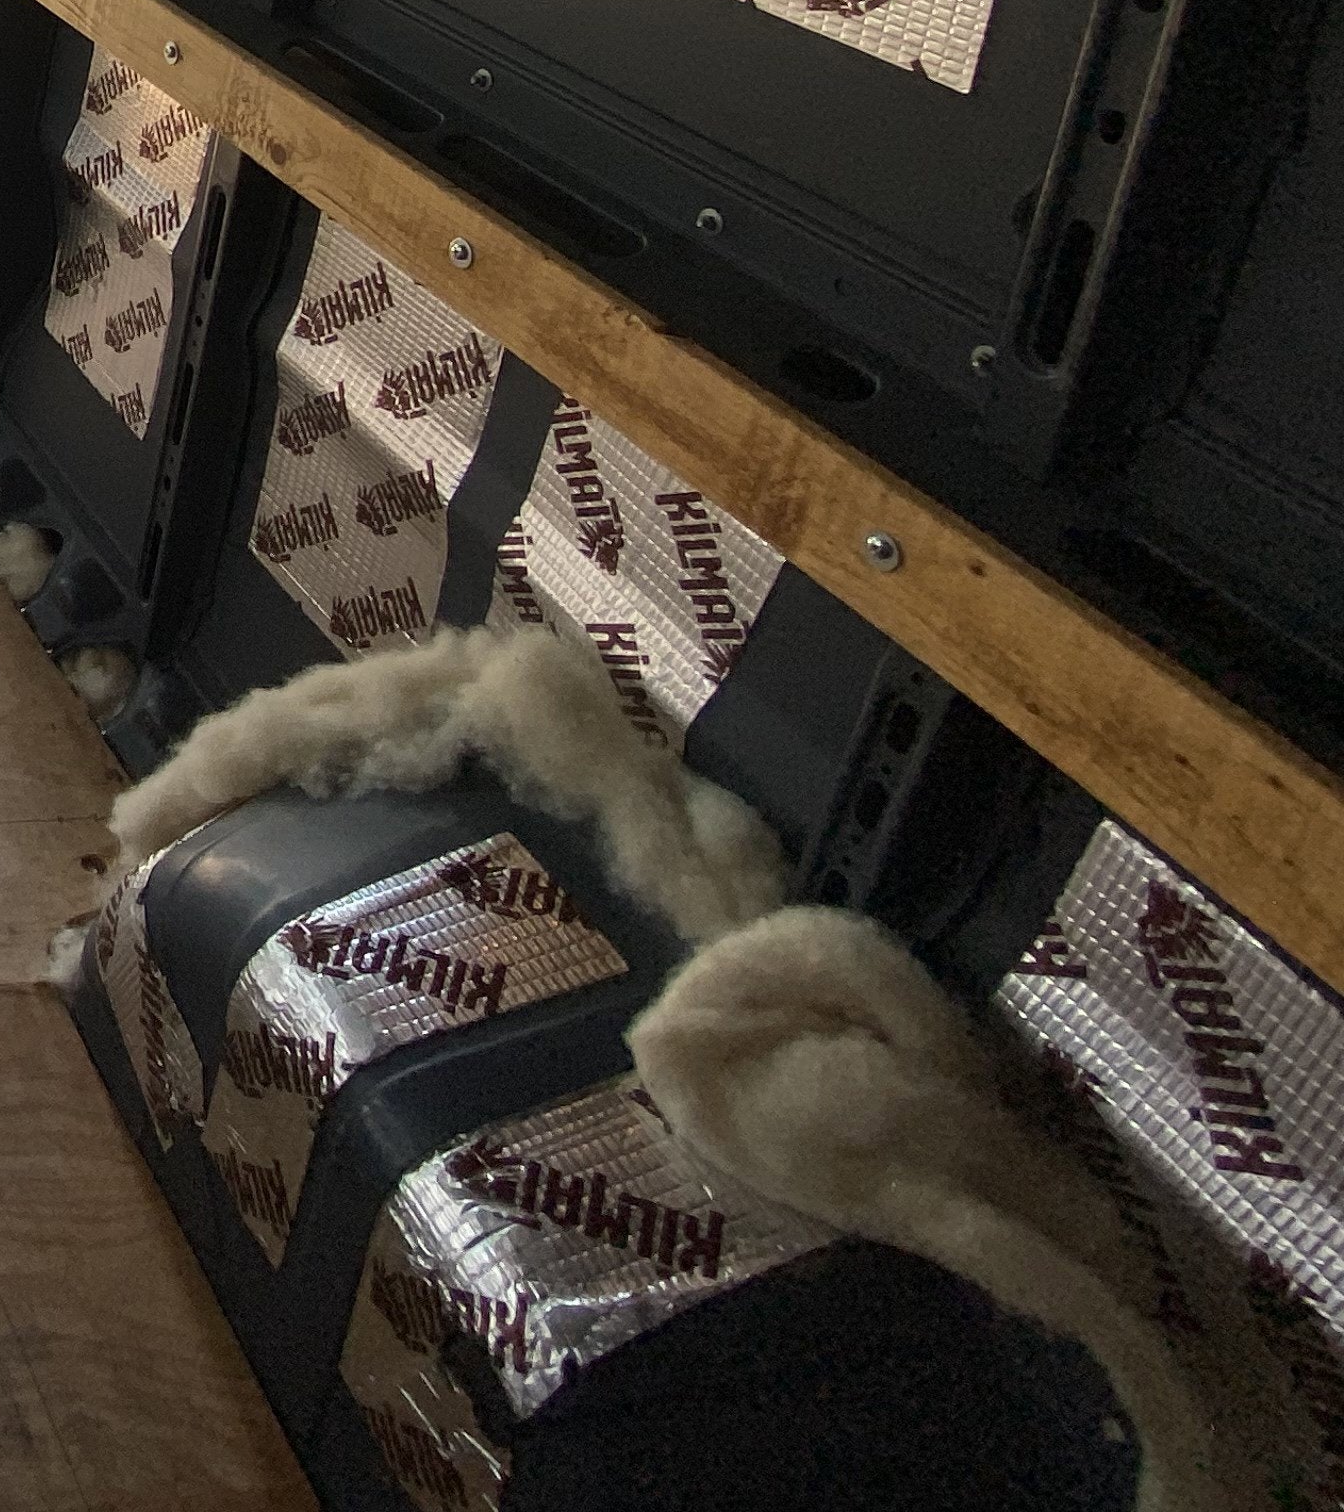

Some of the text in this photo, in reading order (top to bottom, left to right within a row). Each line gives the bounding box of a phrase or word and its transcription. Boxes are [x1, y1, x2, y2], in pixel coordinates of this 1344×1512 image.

[118, 287, 167, 351] KILMAT
[320, 262, 394, 344] KILMAT
[405, 333, 491, 417] KILMAT
[295, 382, 350, 453] KILMAT
[274, 492, 338, 562] KILMAT
[378, 459, 442, 534] KILMAT
[655, 491, 751, 640] KILMAT
[351, 577, 427, 648] KILMAT
[322, 927, 506, 1015] KILMAT
[1145, 953, 1305, 1182] KILMAT
[512, 1161, 724, 1279] KILMAT
